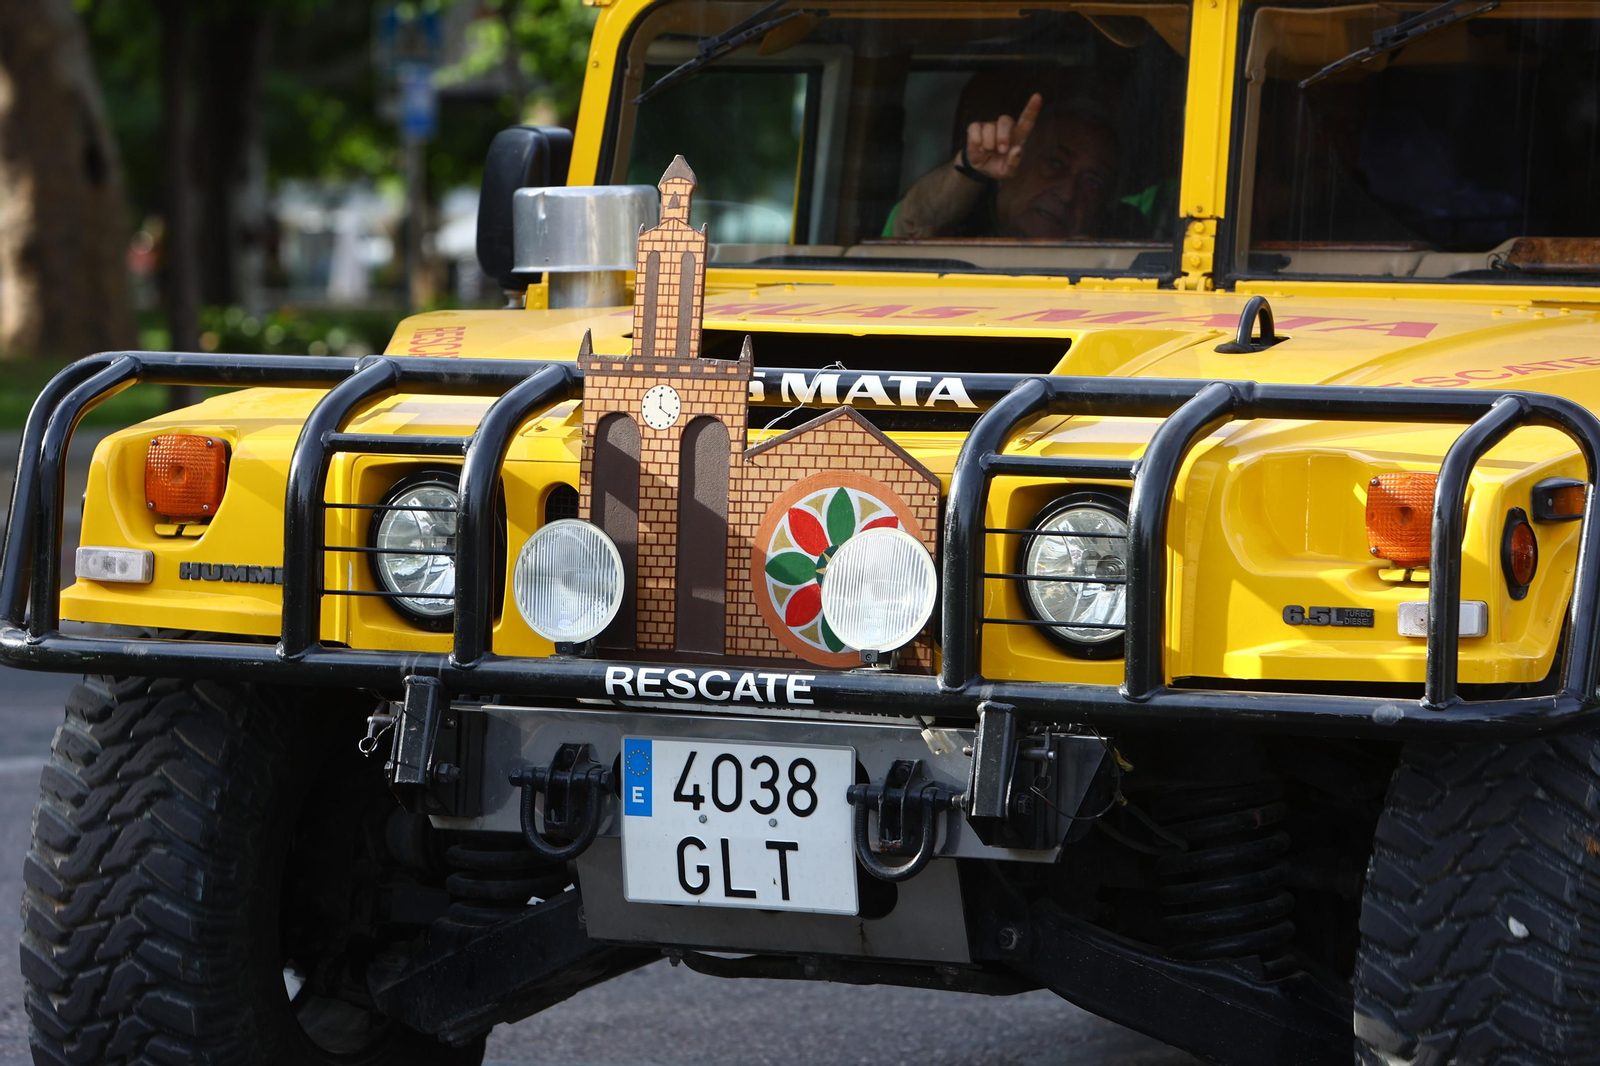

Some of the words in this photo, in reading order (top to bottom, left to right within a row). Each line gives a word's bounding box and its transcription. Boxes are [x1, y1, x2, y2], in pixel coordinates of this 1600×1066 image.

[780, 372, 980, 410] MATA
[179, 561, 284, 585] HUMM
[1282, 605, 1344, 627] 6.5L
[1344, 608, 1372, 618] TURBO
[1344, 617, 1372, 626] DIESEL
[605, 665, 816, 705] RESCATE
[631, 786, 645, 803] E
[673, 751, 818, 817] 4038
[676, 836, 799, 901] GLT
